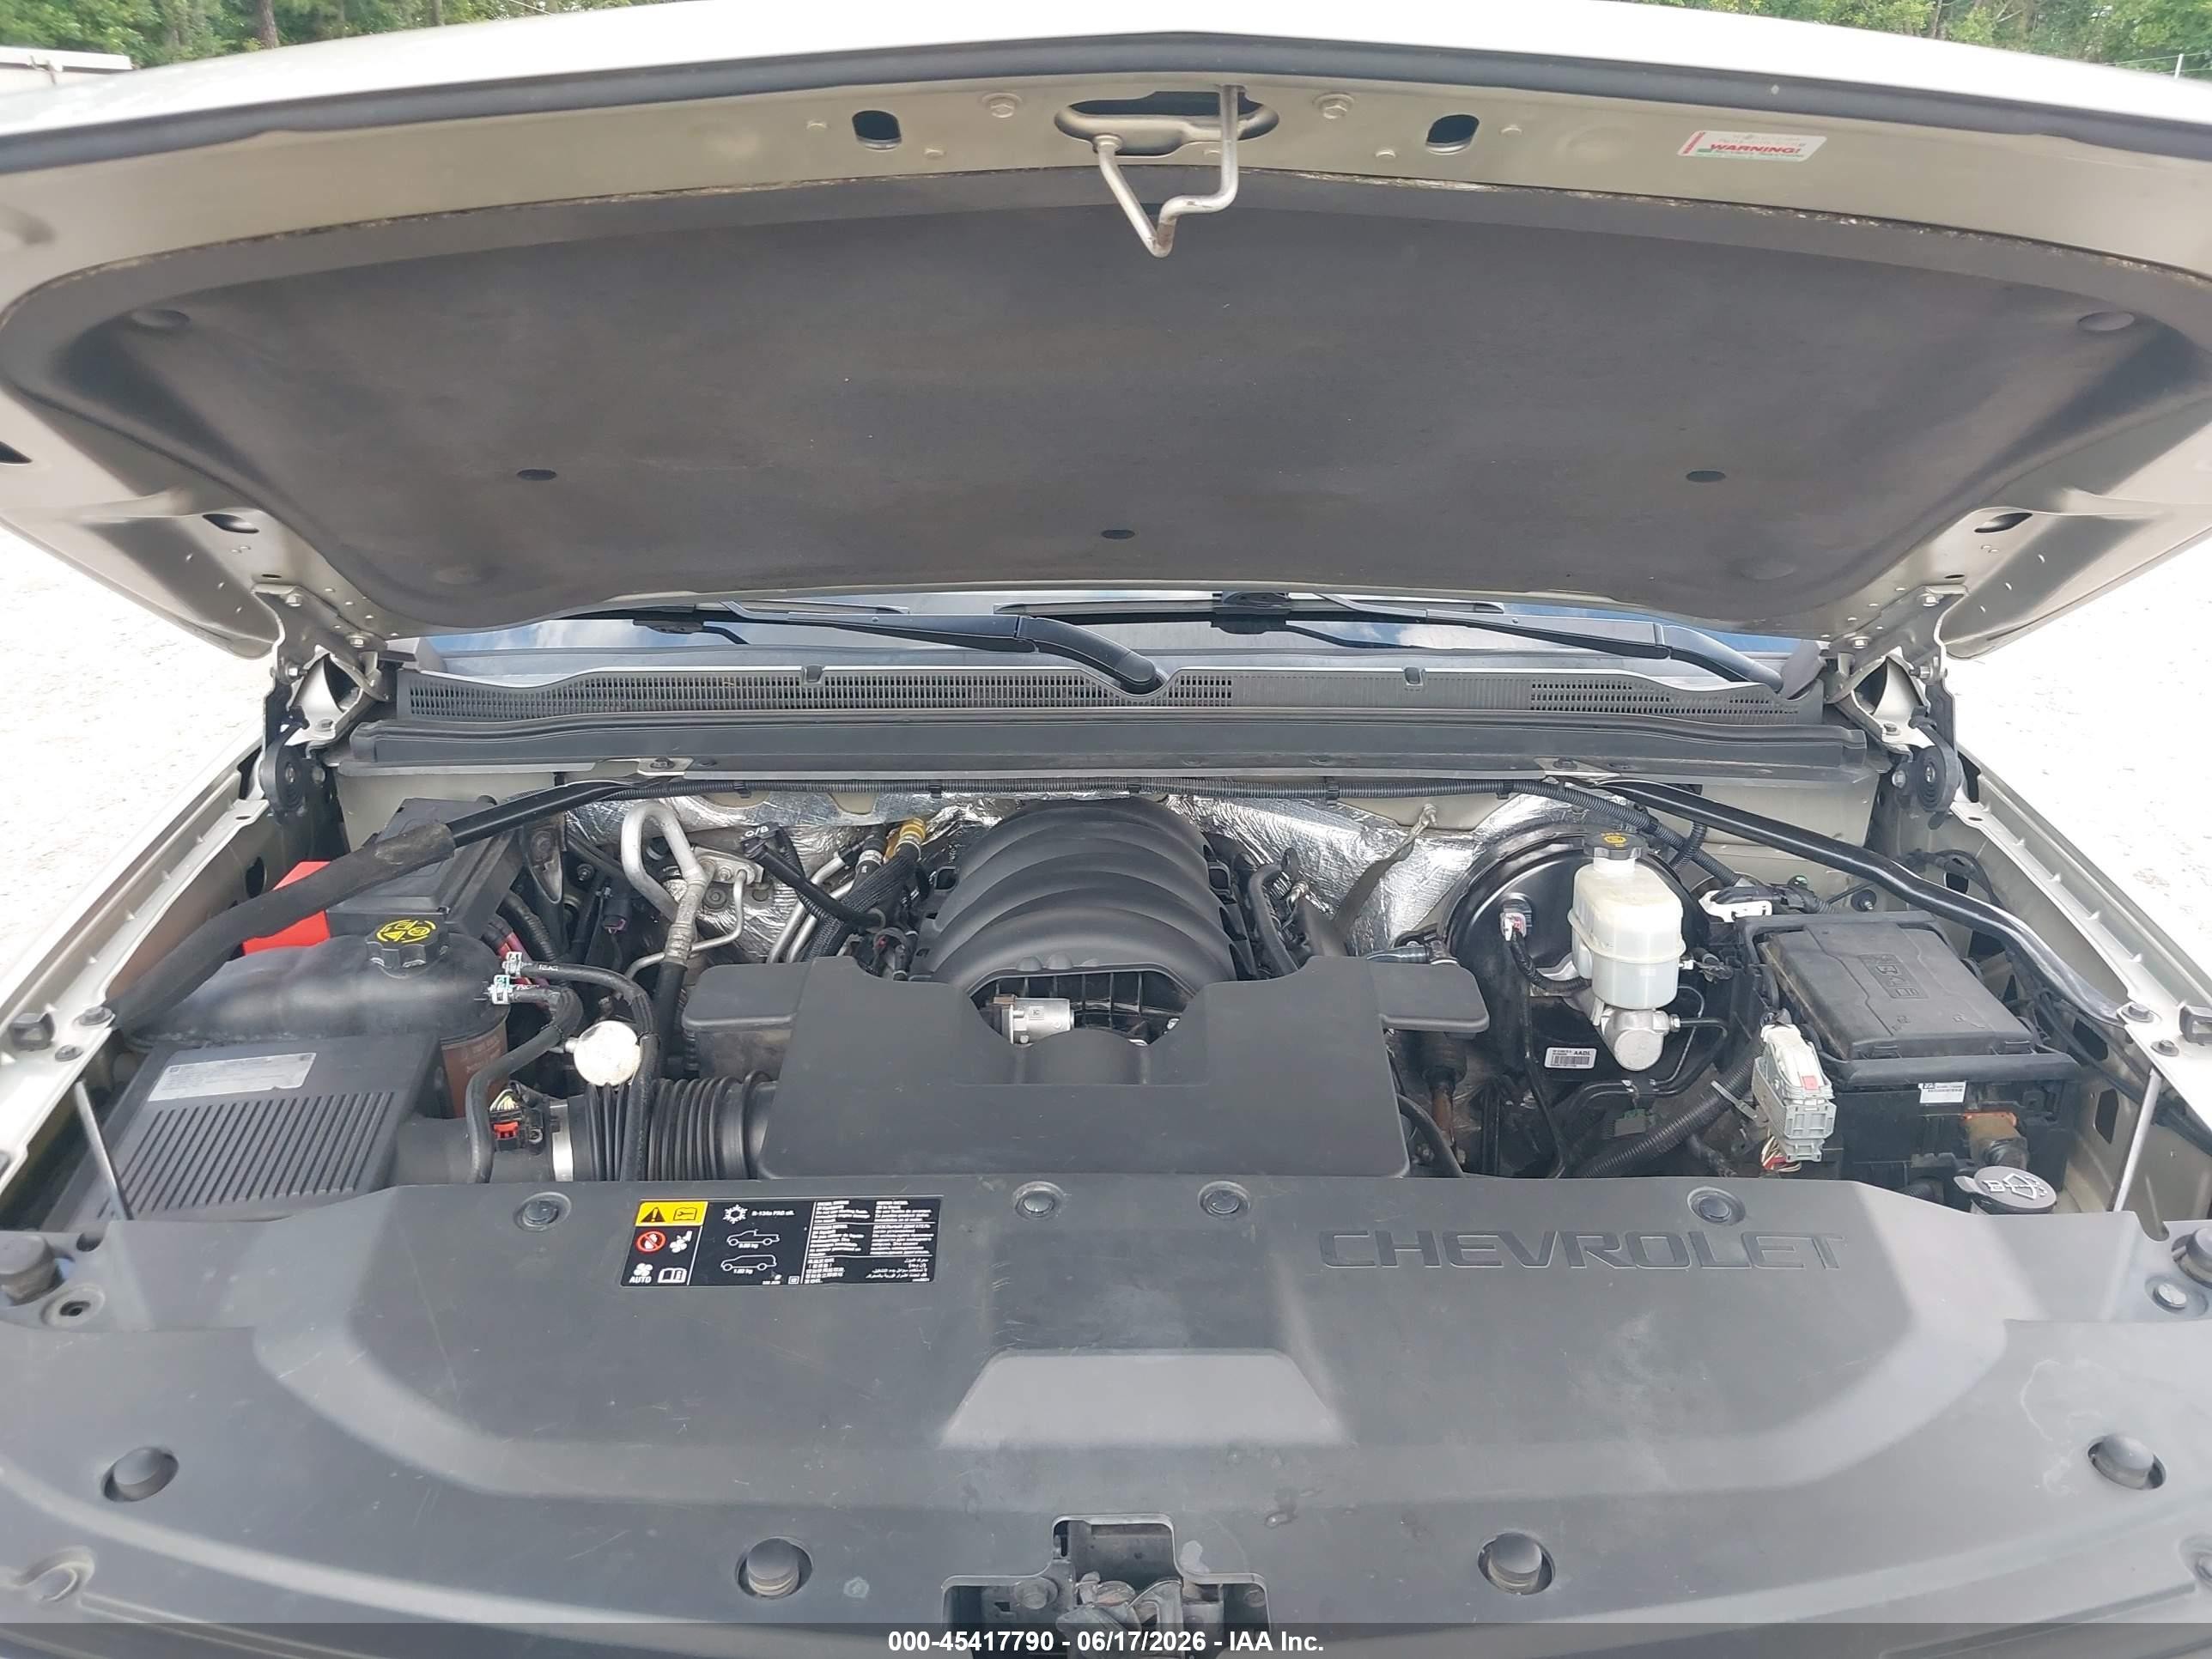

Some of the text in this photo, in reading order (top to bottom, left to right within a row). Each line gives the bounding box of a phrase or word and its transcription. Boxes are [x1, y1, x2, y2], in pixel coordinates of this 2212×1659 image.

[1711, 143, 1802, 154] WARNING!
[1318, 1229, 1846, 1271] CHEVROLET
[629, 1275, 653, 1284] AUTO
